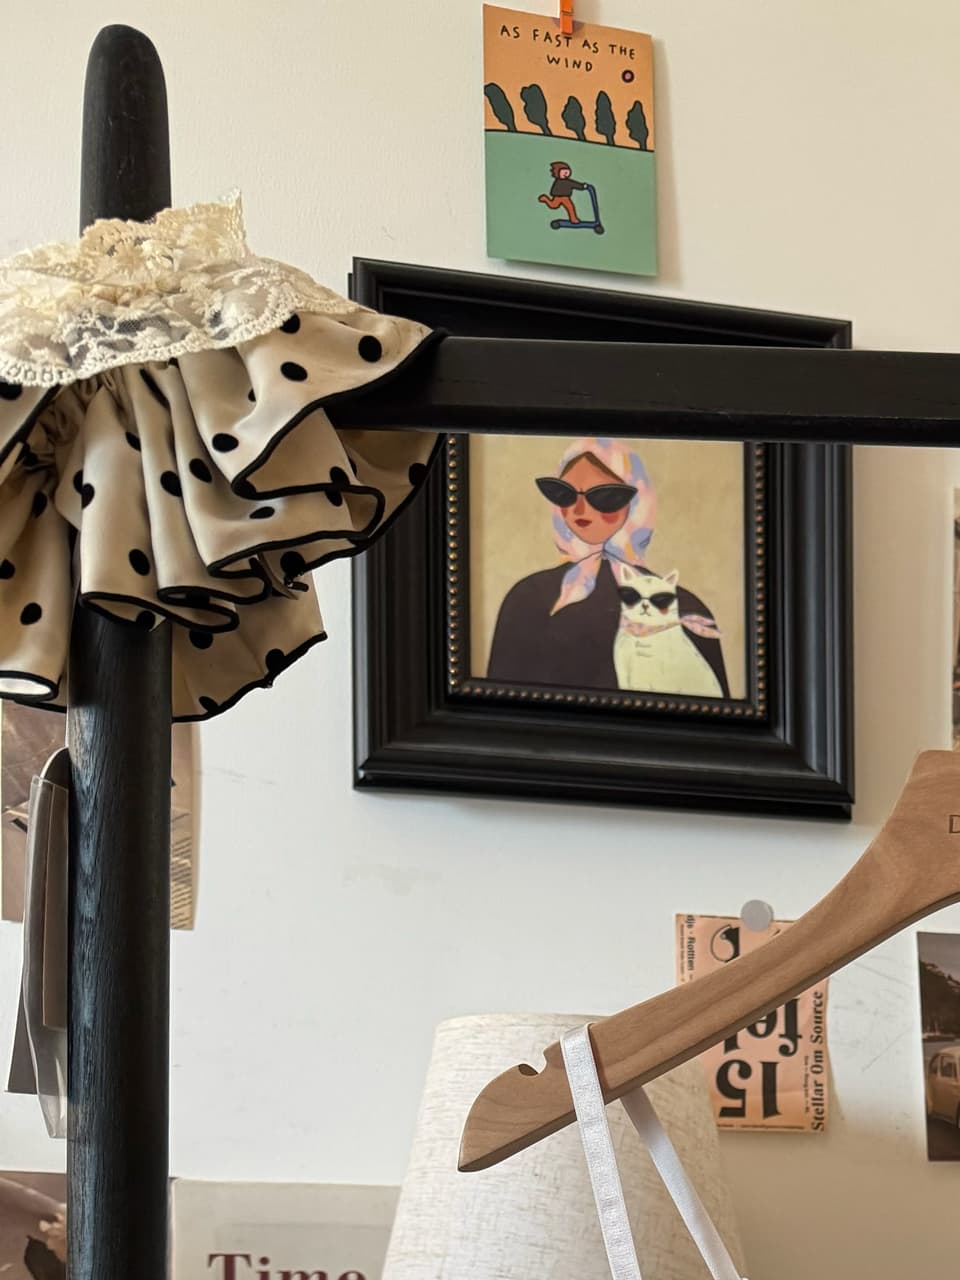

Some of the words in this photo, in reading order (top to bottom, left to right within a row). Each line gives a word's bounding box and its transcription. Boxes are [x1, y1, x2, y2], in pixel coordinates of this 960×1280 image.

[500, 25, 520, 39] AS
[532, 29, 573, 47] FAST
[582, 39, 600, 53] AS
[609, 44, 636, 60] THE
[546, 54, 593, 72] WIND
[810, 991, 825, 1045] Source
[813, 1049, 825, 1075] Om
[715, 1059, 783, 1119] 15
[810, 1082, 825, 1132] Stellar
